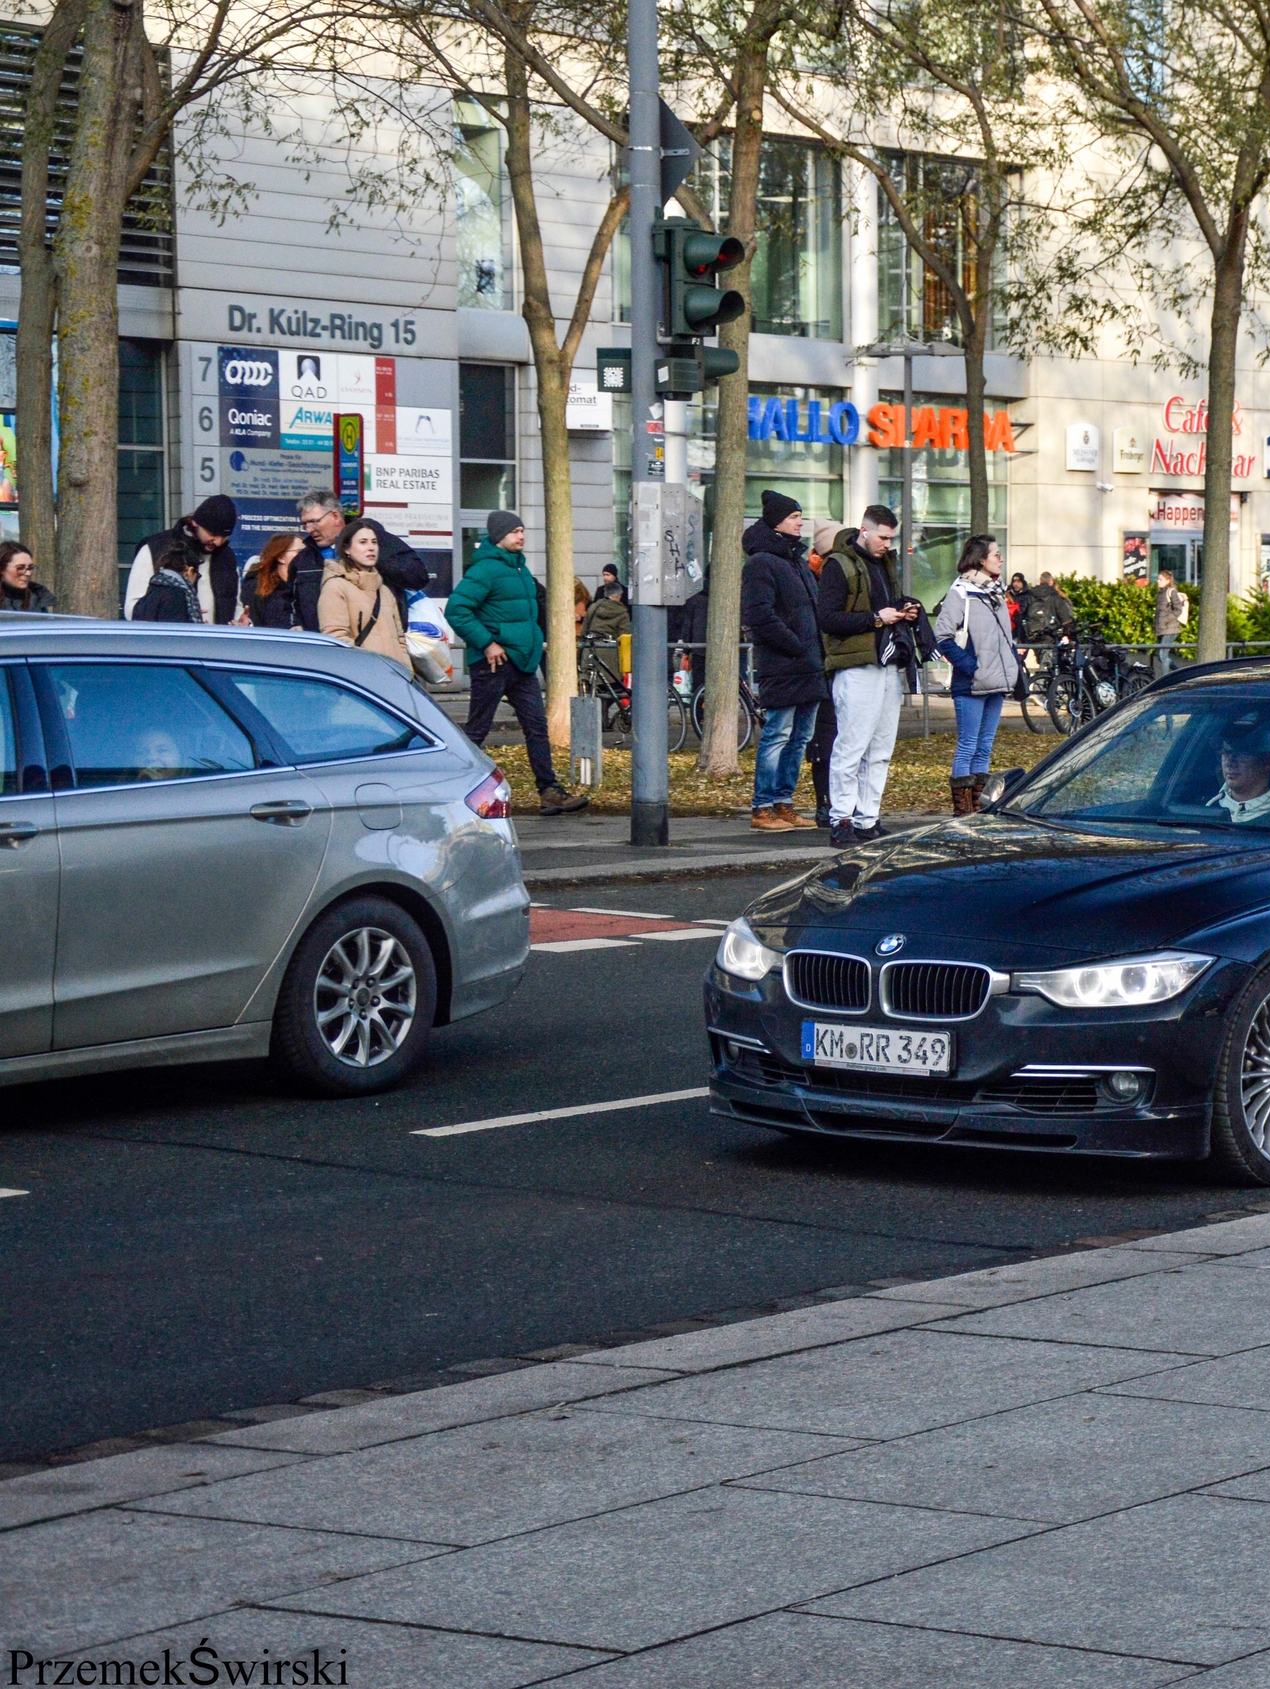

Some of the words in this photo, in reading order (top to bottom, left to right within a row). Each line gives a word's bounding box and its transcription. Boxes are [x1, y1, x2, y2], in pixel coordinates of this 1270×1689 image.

[228, 304, 261, 333] Dr.
[269, 308, 383, 349] Külz-Ring
[390, 318, 416, 346] 15
[198, 356, 212, 381] 7
[291, 385, 327, 399] QAD
[198, 406, 213, 432] 6
[228, 408, 272, 427] Qoniac
[867, 403, 1015, 452] SPARA
[247, 429, 272, 439] Company
[200, 457, 215, 482] 5
[1150, 438, 1256, 478] Nachar
[376, 467, 396, 476] BNP
[399, 468, 440, 478] PARIBAS
[376, 479, 400, 489] REAL
[403, 480, 437, 490] ESTATE
[805, 1043, 811, 1052] D
[815, 1028, 844, 1059] KM
[860, 1032, 891, 1063] RR
[897, 1035, 946, 1066] 349
